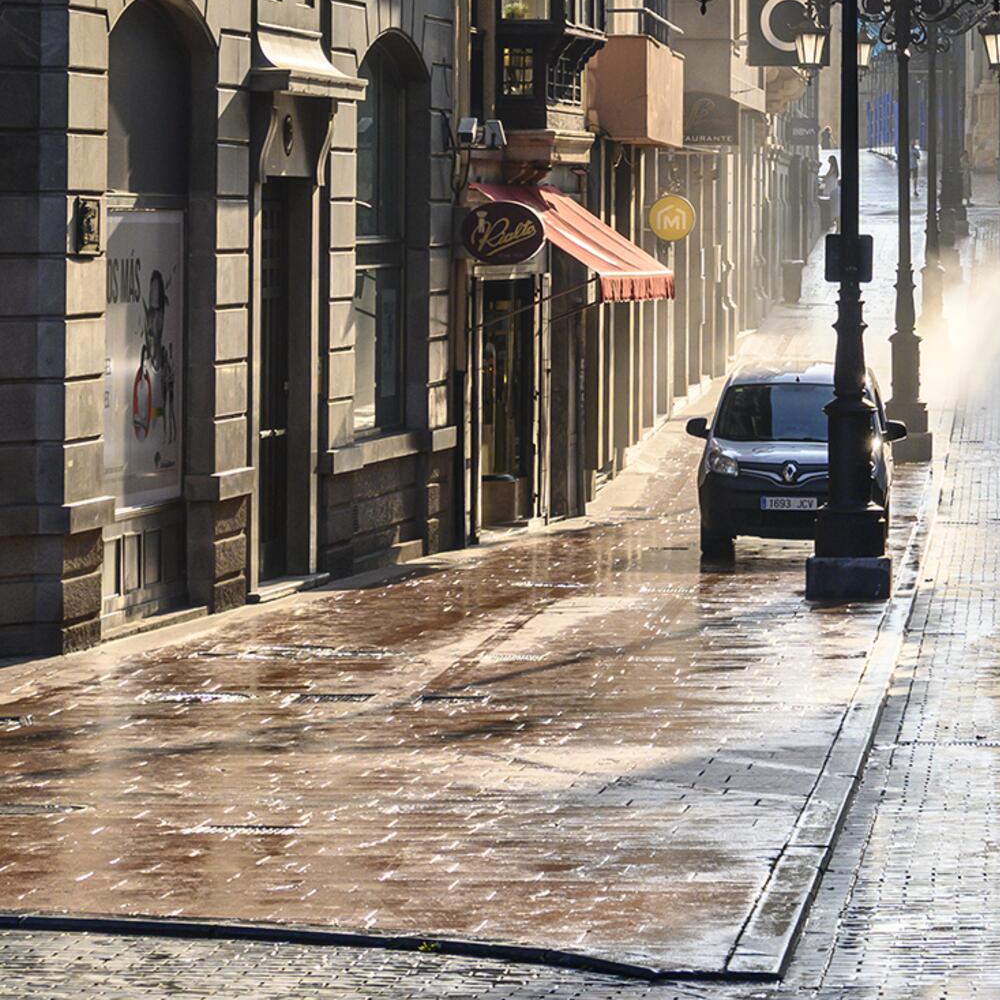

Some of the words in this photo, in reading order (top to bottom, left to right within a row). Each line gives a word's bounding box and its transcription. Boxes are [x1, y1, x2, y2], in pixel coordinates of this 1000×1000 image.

[471, 217, 537, 257] Rialto
[120, 249, 141, 303] MÁS
[770, 498, 791, 509] 1693
